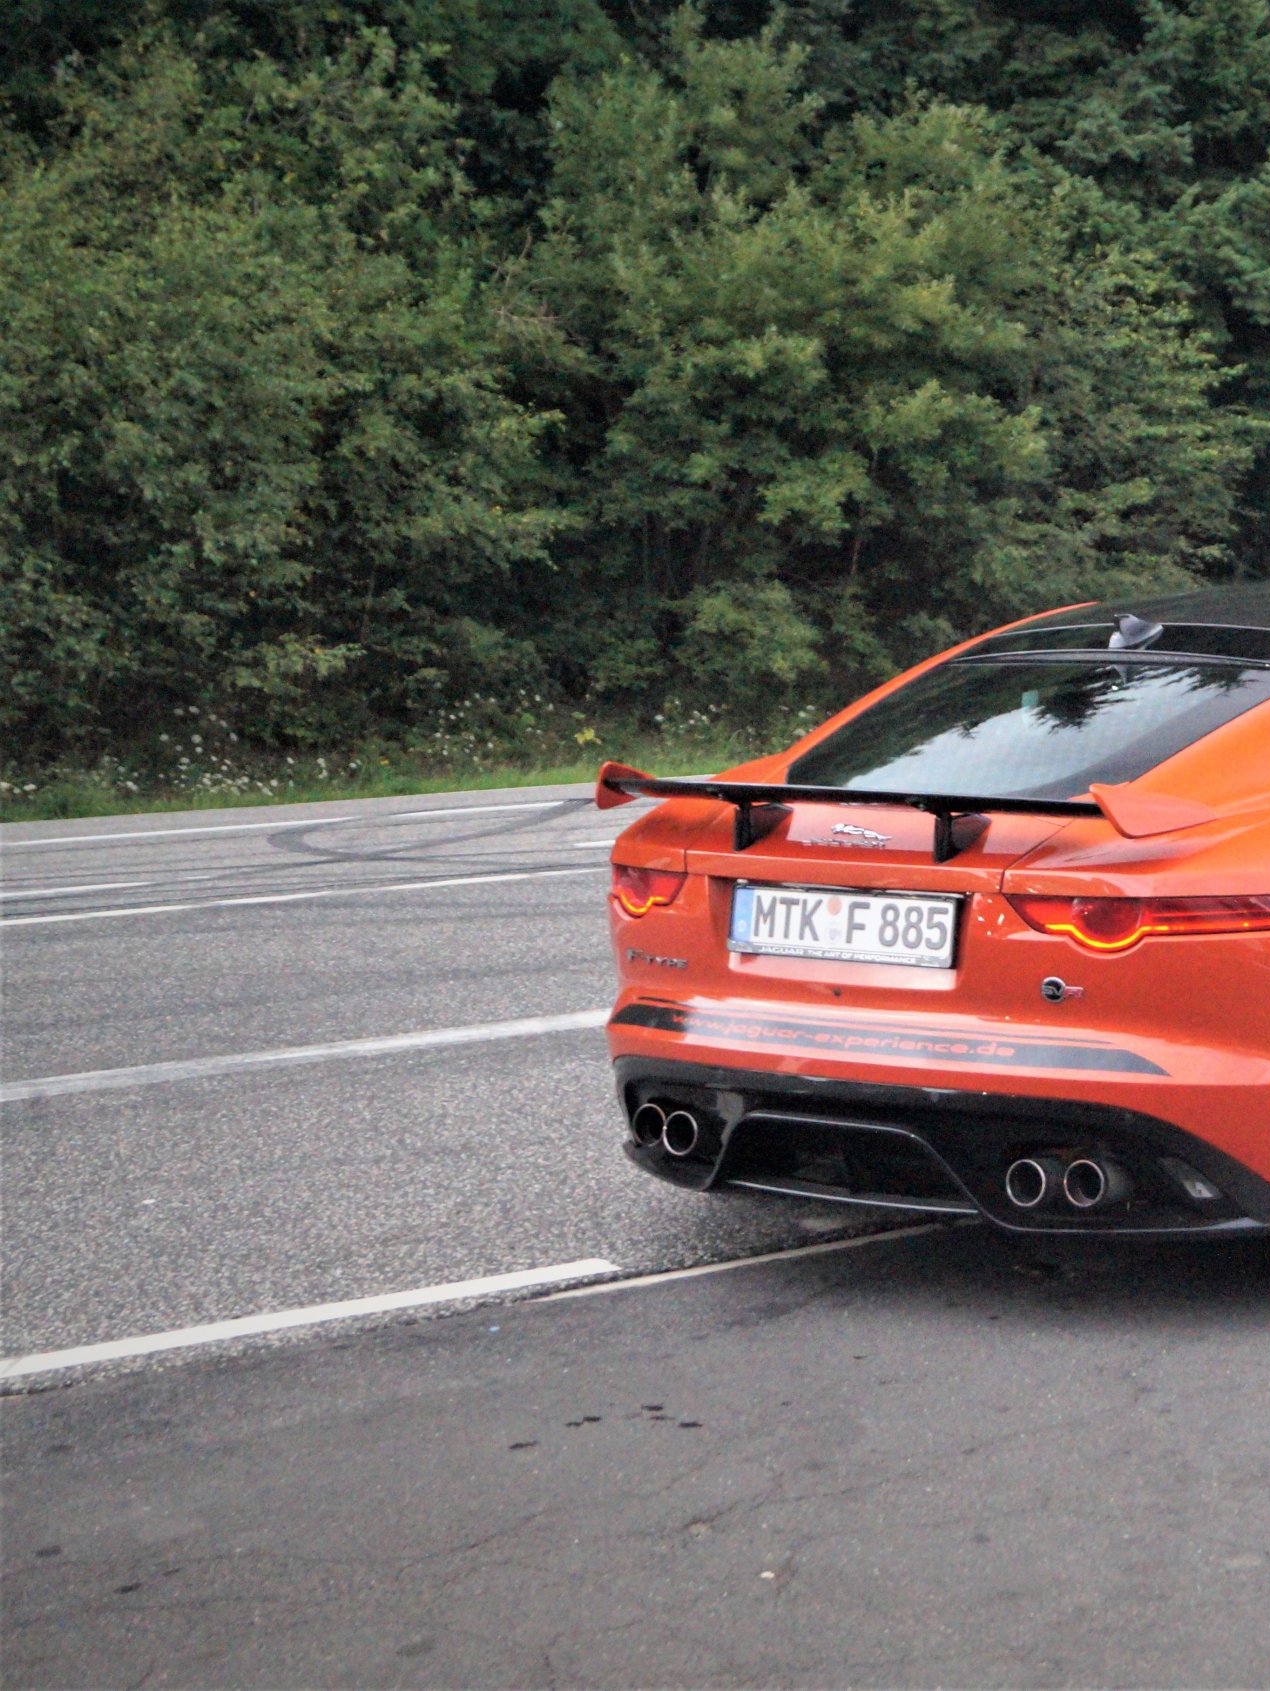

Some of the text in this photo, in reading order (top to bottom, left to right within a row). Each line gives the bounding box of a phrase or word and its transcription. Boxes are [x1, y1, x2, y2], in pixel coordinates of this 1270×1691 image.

[753, 894, 949, 951] MTK F 885
[759, 945, 804, 956] JAGUAR
[807, 949, 823, 957] THE
[853, 952, 917, 965] PERFORMANCE
[672, 1014, 1015, 1057] www.jaguar-experience.de
